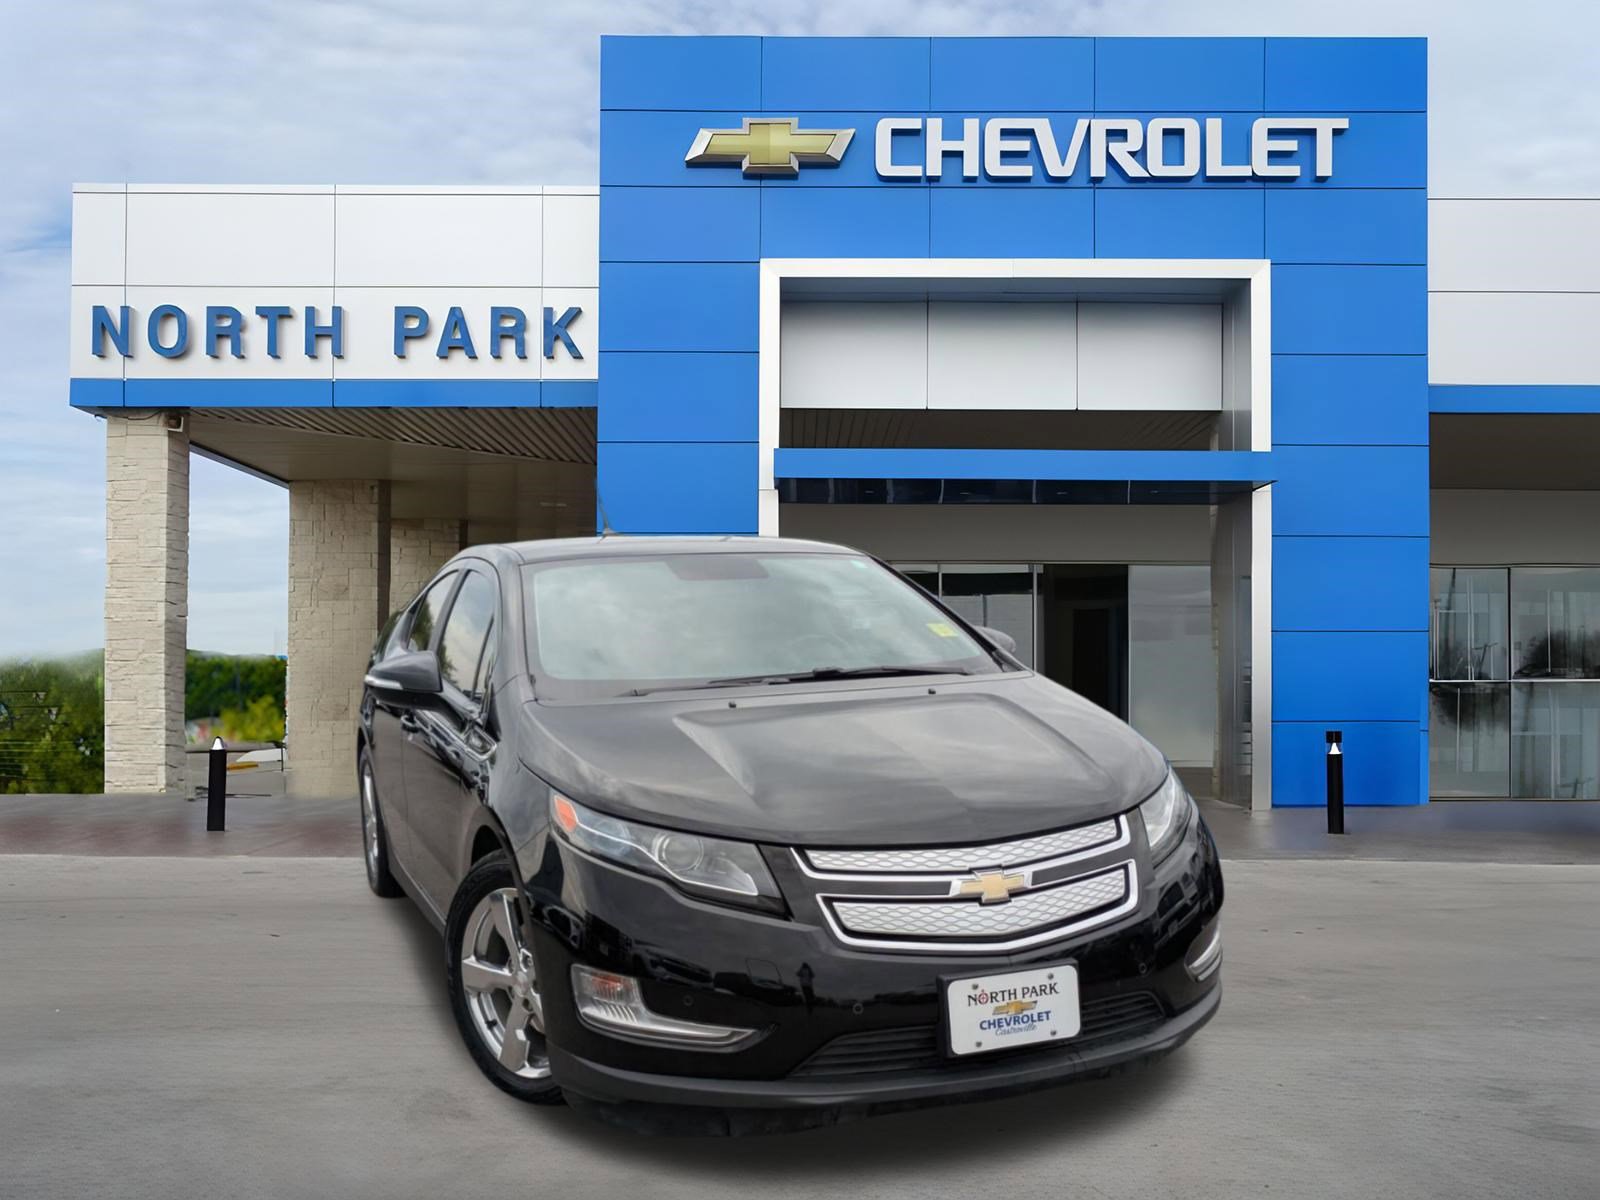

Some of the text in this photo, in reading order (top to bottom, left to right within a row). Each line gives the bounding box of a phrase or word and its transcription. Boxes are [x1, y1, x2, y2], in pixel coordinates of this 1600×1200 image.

[874, 117, 1349, 181] CHEVROLET
[91, 304, 585, 360] NORTH PARK
[968, 983, 1059, 1006] NORTH PARK
[980, 1011, 1051, 1030] CHEVROLET
